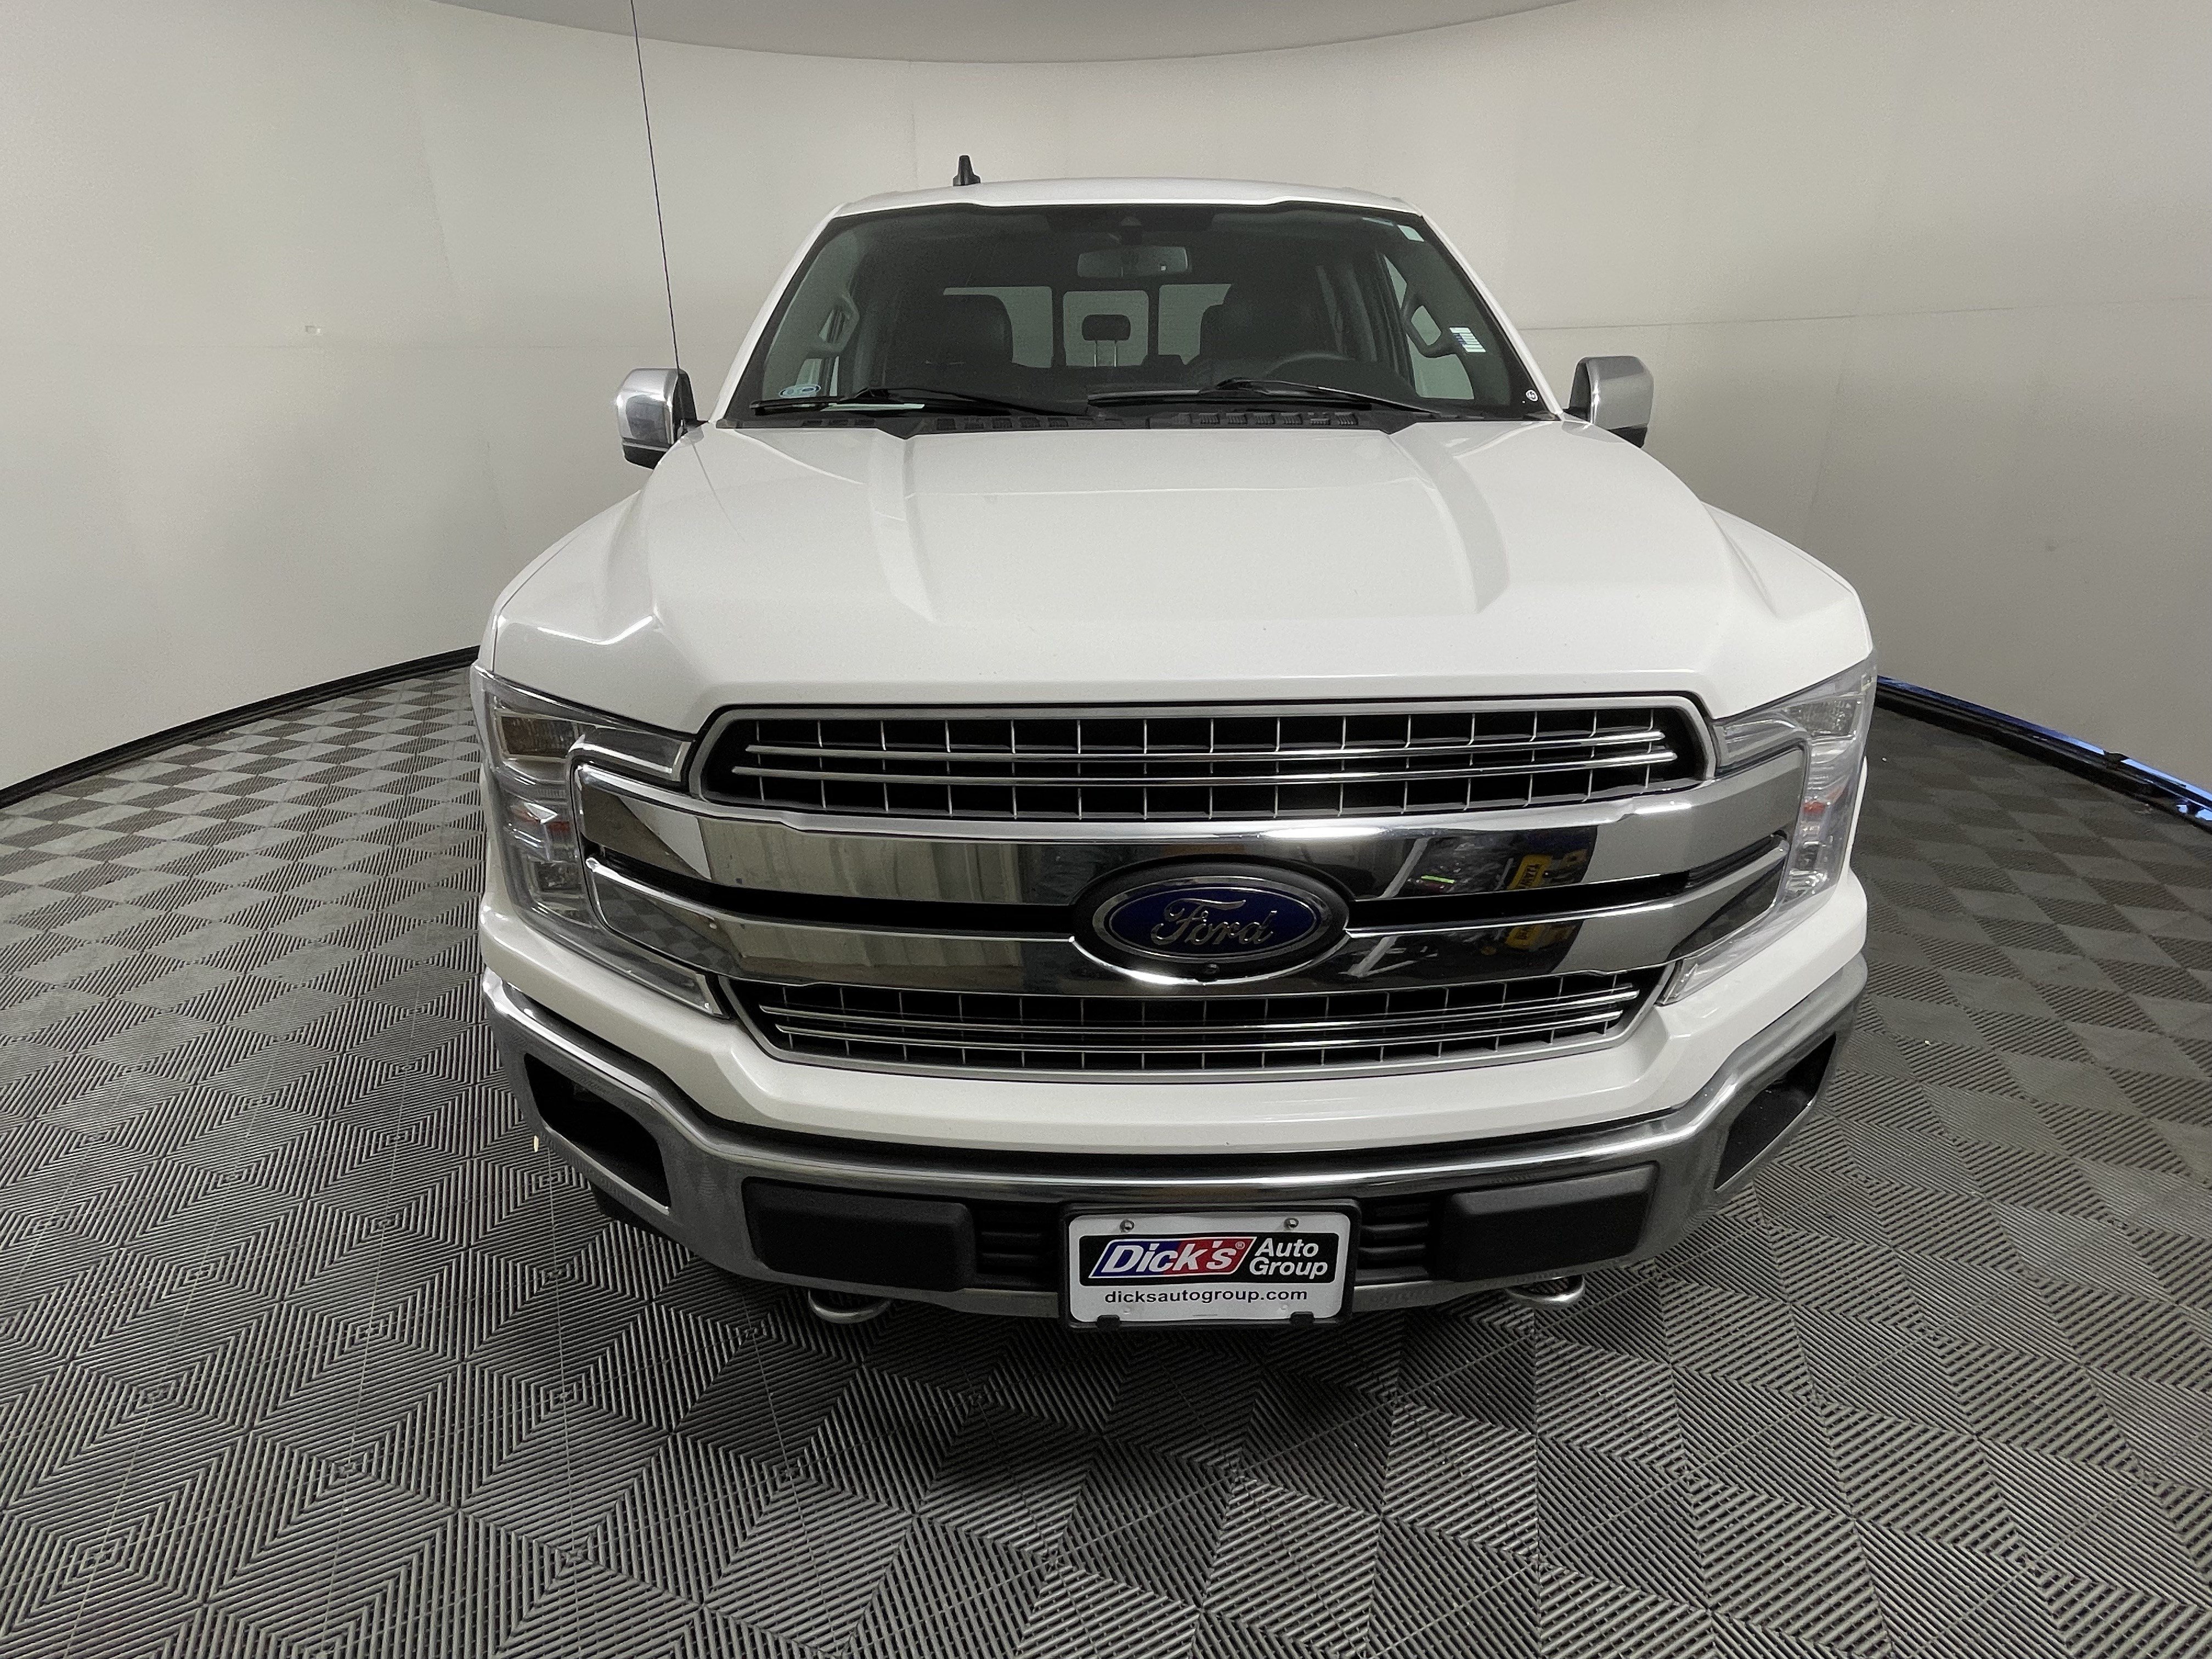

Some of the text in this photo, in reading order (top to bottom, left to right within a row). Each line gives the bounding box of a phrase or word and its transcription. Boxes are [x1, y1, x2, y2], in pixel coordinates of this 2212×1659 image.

[1152, 898, 1277, 945] Ford
[1101, 1241, 1237, 1273] Dick's
[1255, 1238, 1319, 1257] Auto
[1249, 1257, 1328, 1279] Group
[1105, 1290, 1307, 1304] dicksautogroup.com
